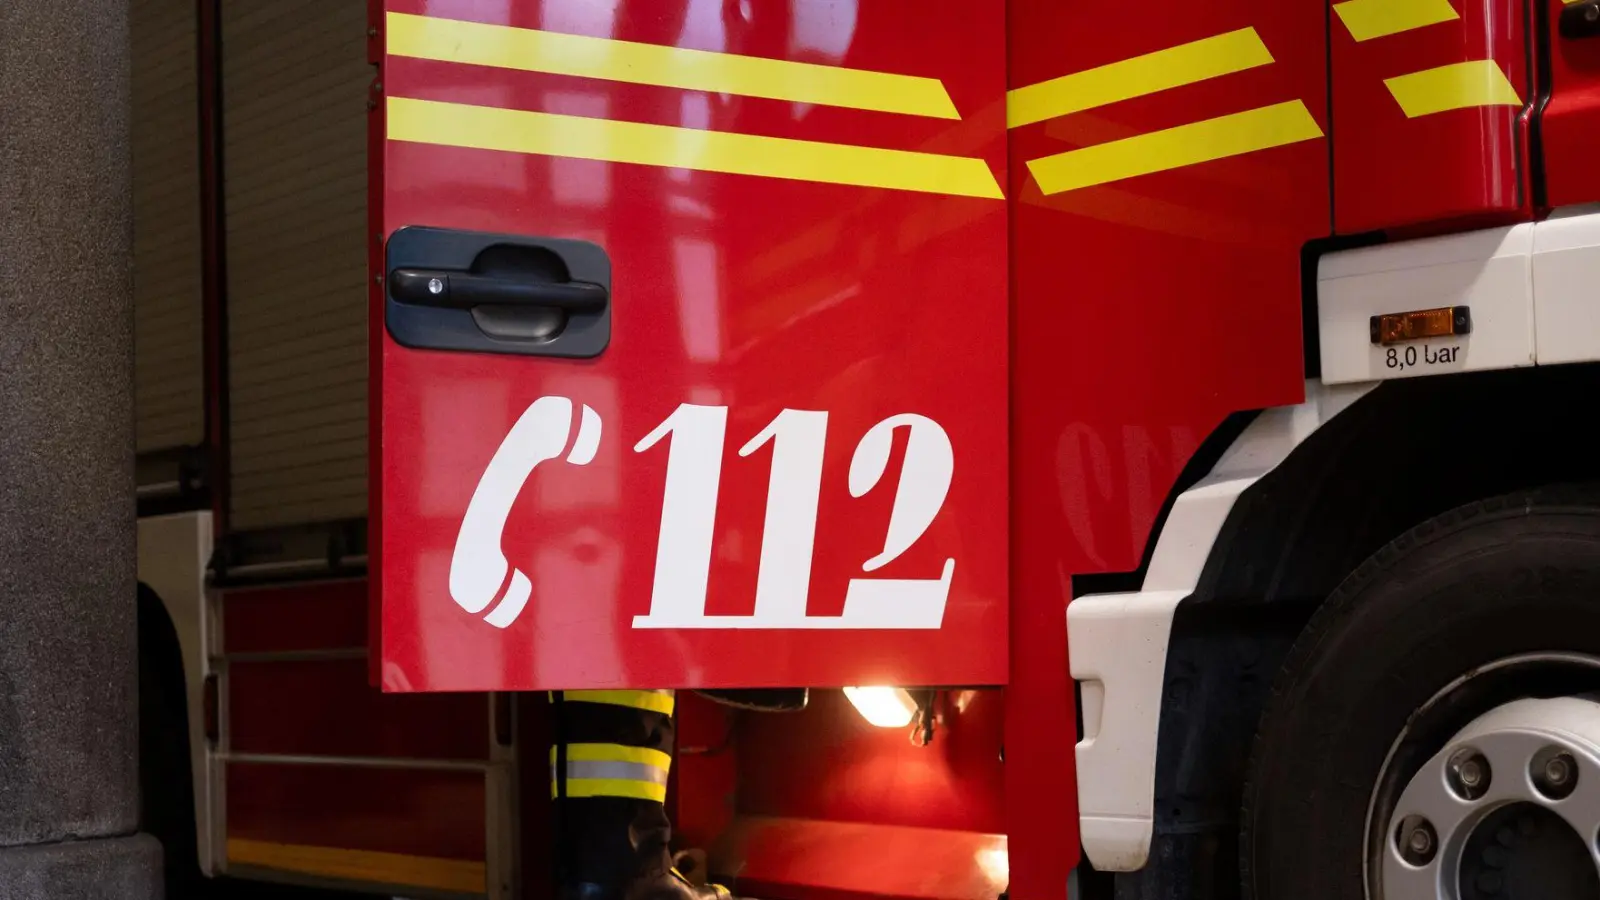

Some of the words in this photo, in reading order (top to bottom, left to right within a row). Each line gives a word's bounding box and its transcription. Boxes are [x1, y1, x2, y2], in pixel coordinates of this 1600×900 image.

[1386, 346, 1417, 371] 8,0
[1424, 345, 1460, 364] bar
[631, 403, 955, 629] 112
